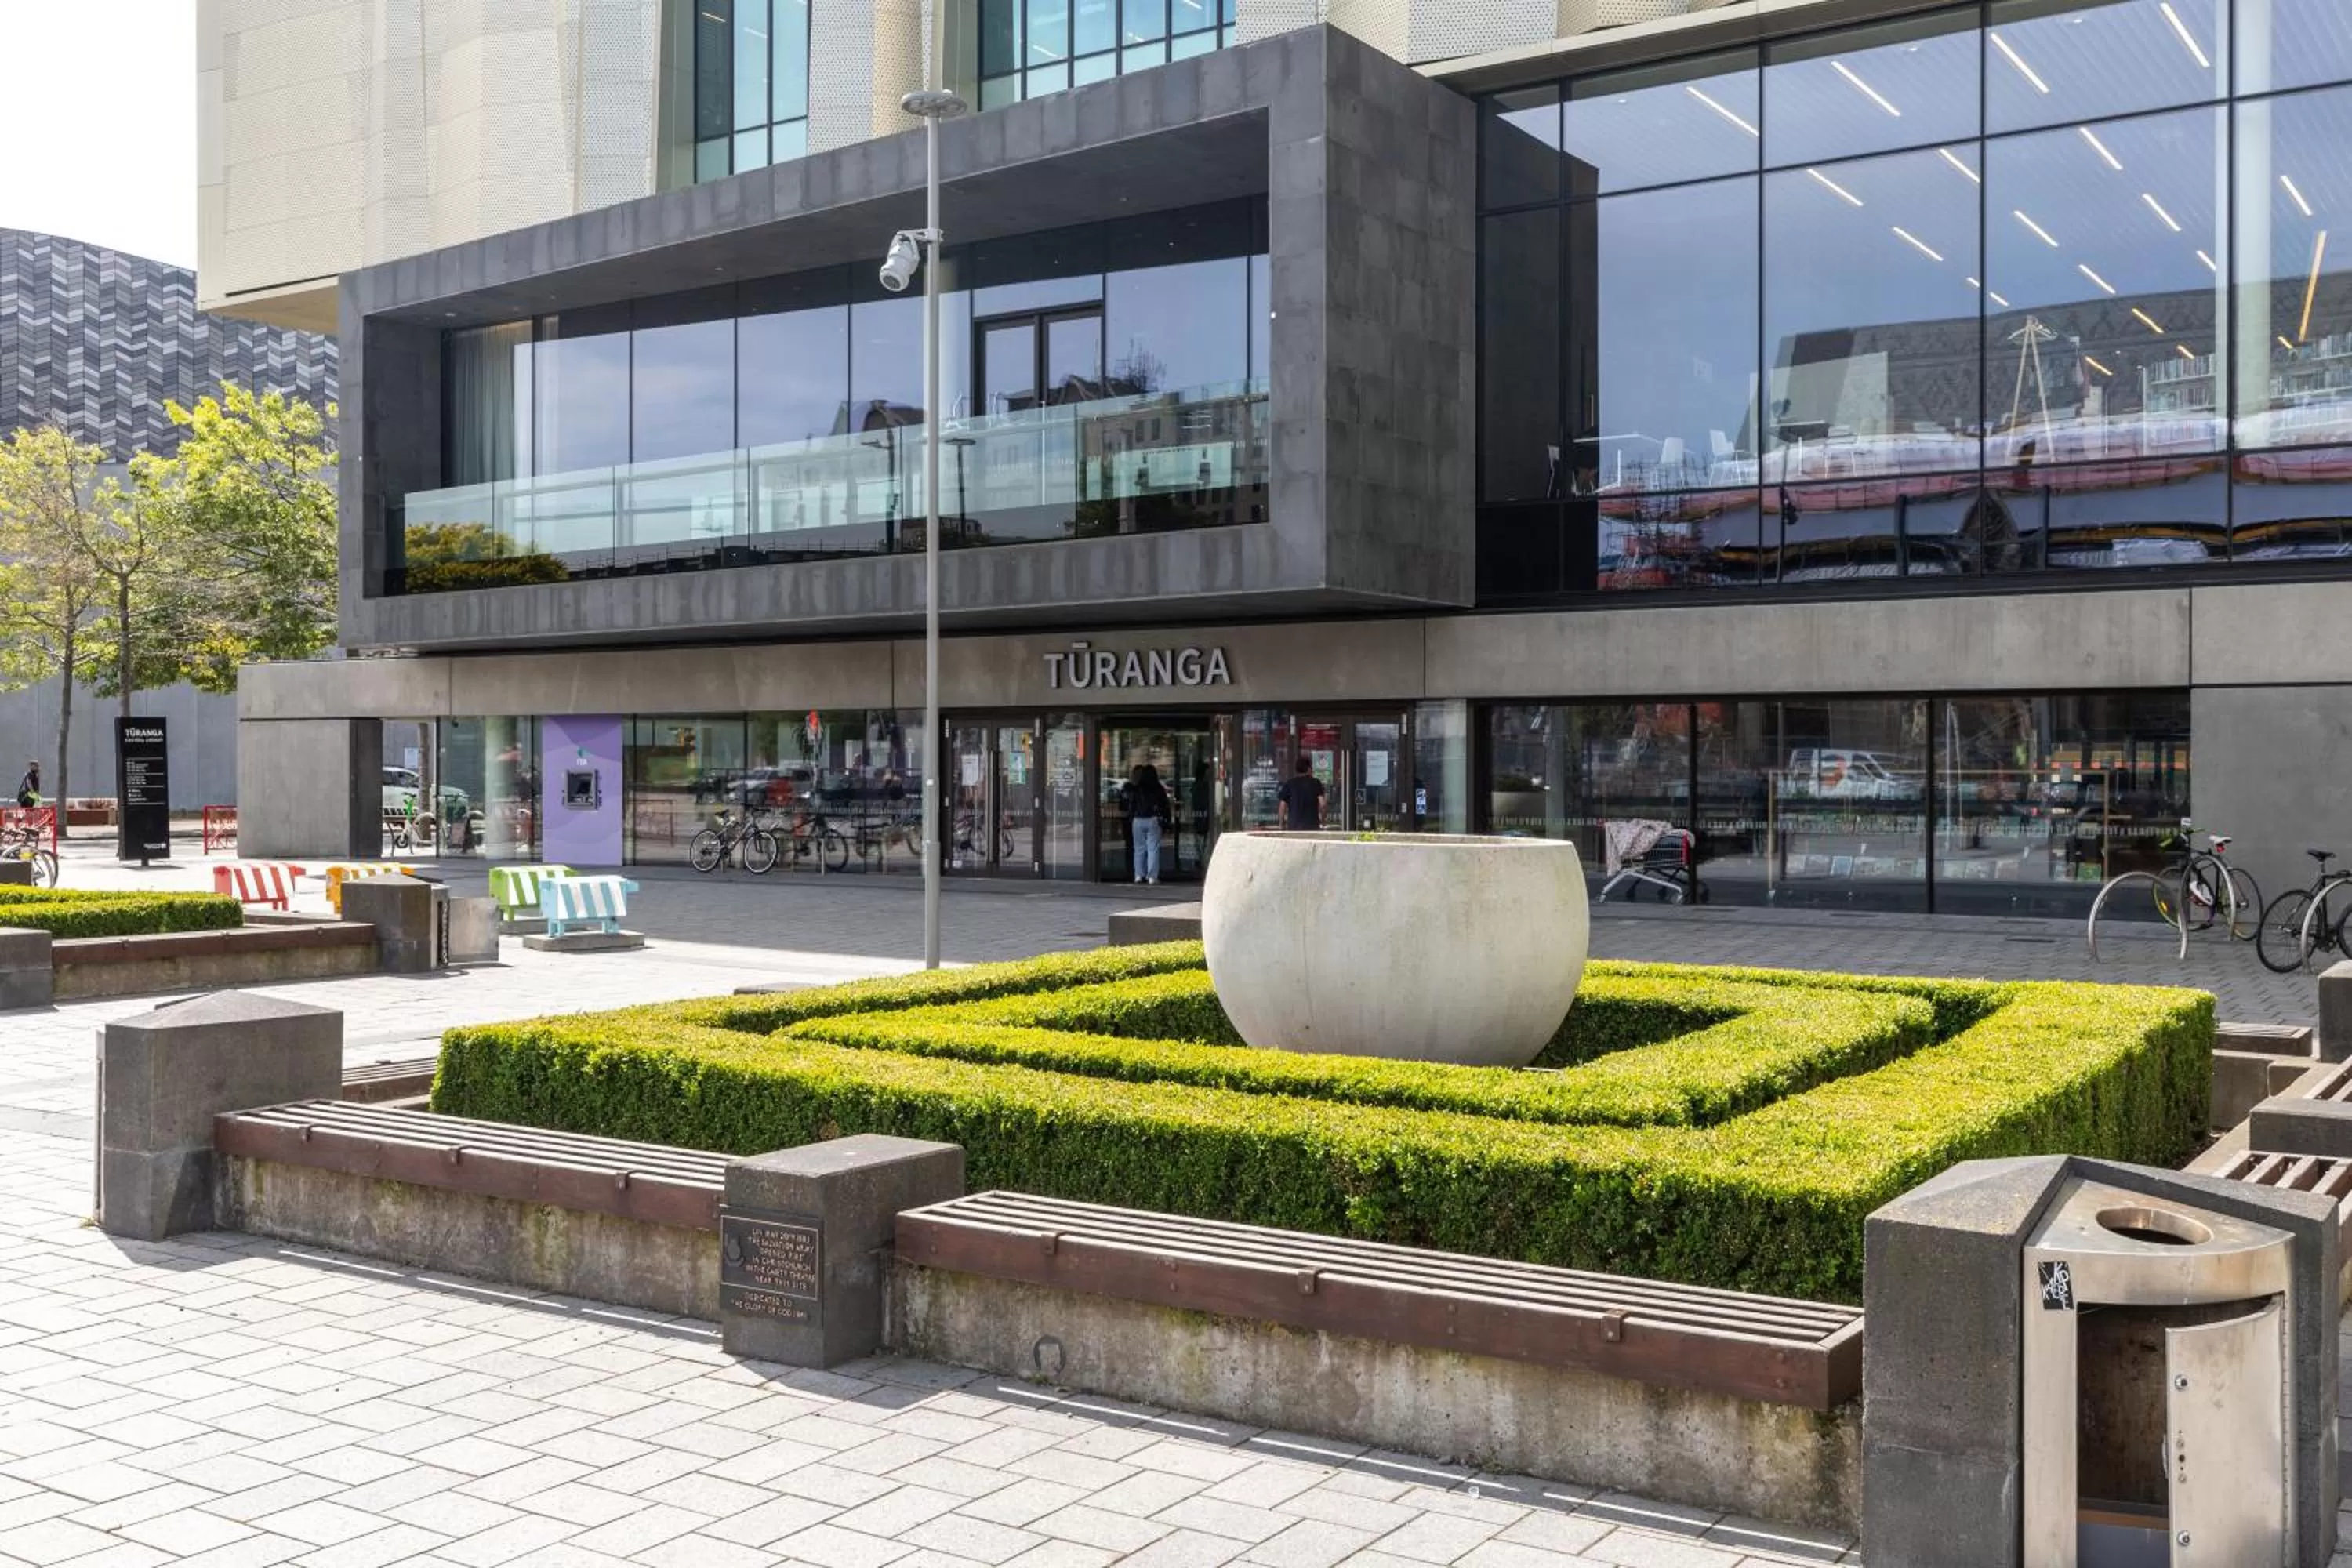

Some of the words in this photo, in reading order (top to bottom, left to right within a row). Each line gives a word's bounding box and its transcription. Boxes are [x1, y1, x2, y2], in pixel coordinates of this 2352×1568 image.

[1043, 641, 1231, 688] TŪRANGA
[125, 728, 163, 736] TŪRANGA
[761, 1238, 795, 1250] SALVATION
[796, 1244, 815, 1254] ARMY
[744, 1301, 766, 1312] GLORY
[777, 1307, 792, 1317] GOD
[783, 1298, 793, 1308] TO
